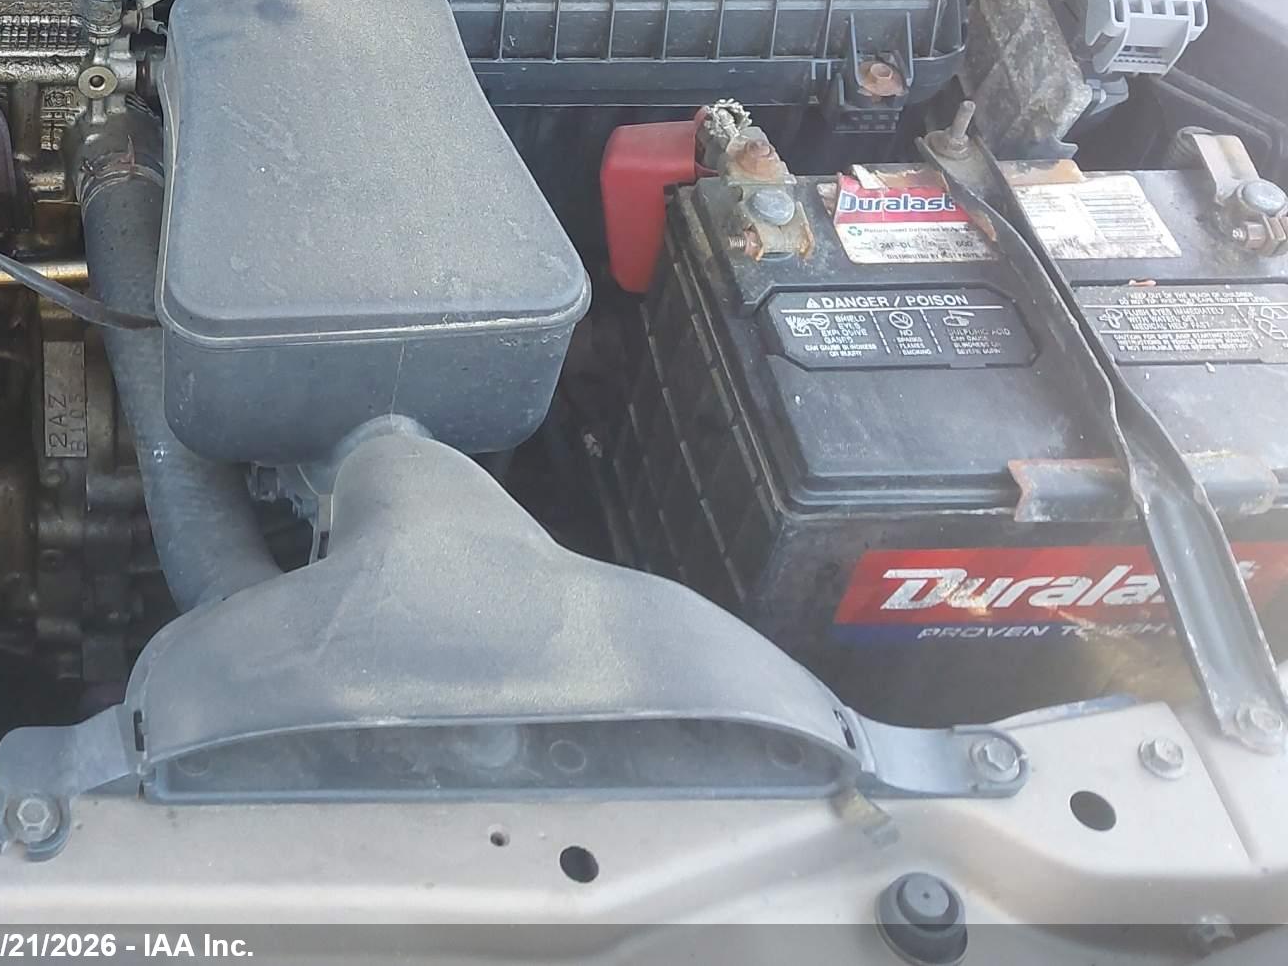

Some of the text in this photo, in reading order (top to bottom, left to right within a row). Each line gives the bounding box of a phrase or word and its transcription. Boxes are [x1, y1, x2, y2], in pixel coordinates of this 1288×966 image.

[839, 189, 957, 213] Duralast
[820, 296, 890, 309] DANGER
[904, 294, 969, 306] POISON
[47, 393, 68, 448] 2AZ
[880, 565, 1165, 610] Durala
[916, 625, 1050, 639] PROVEN
